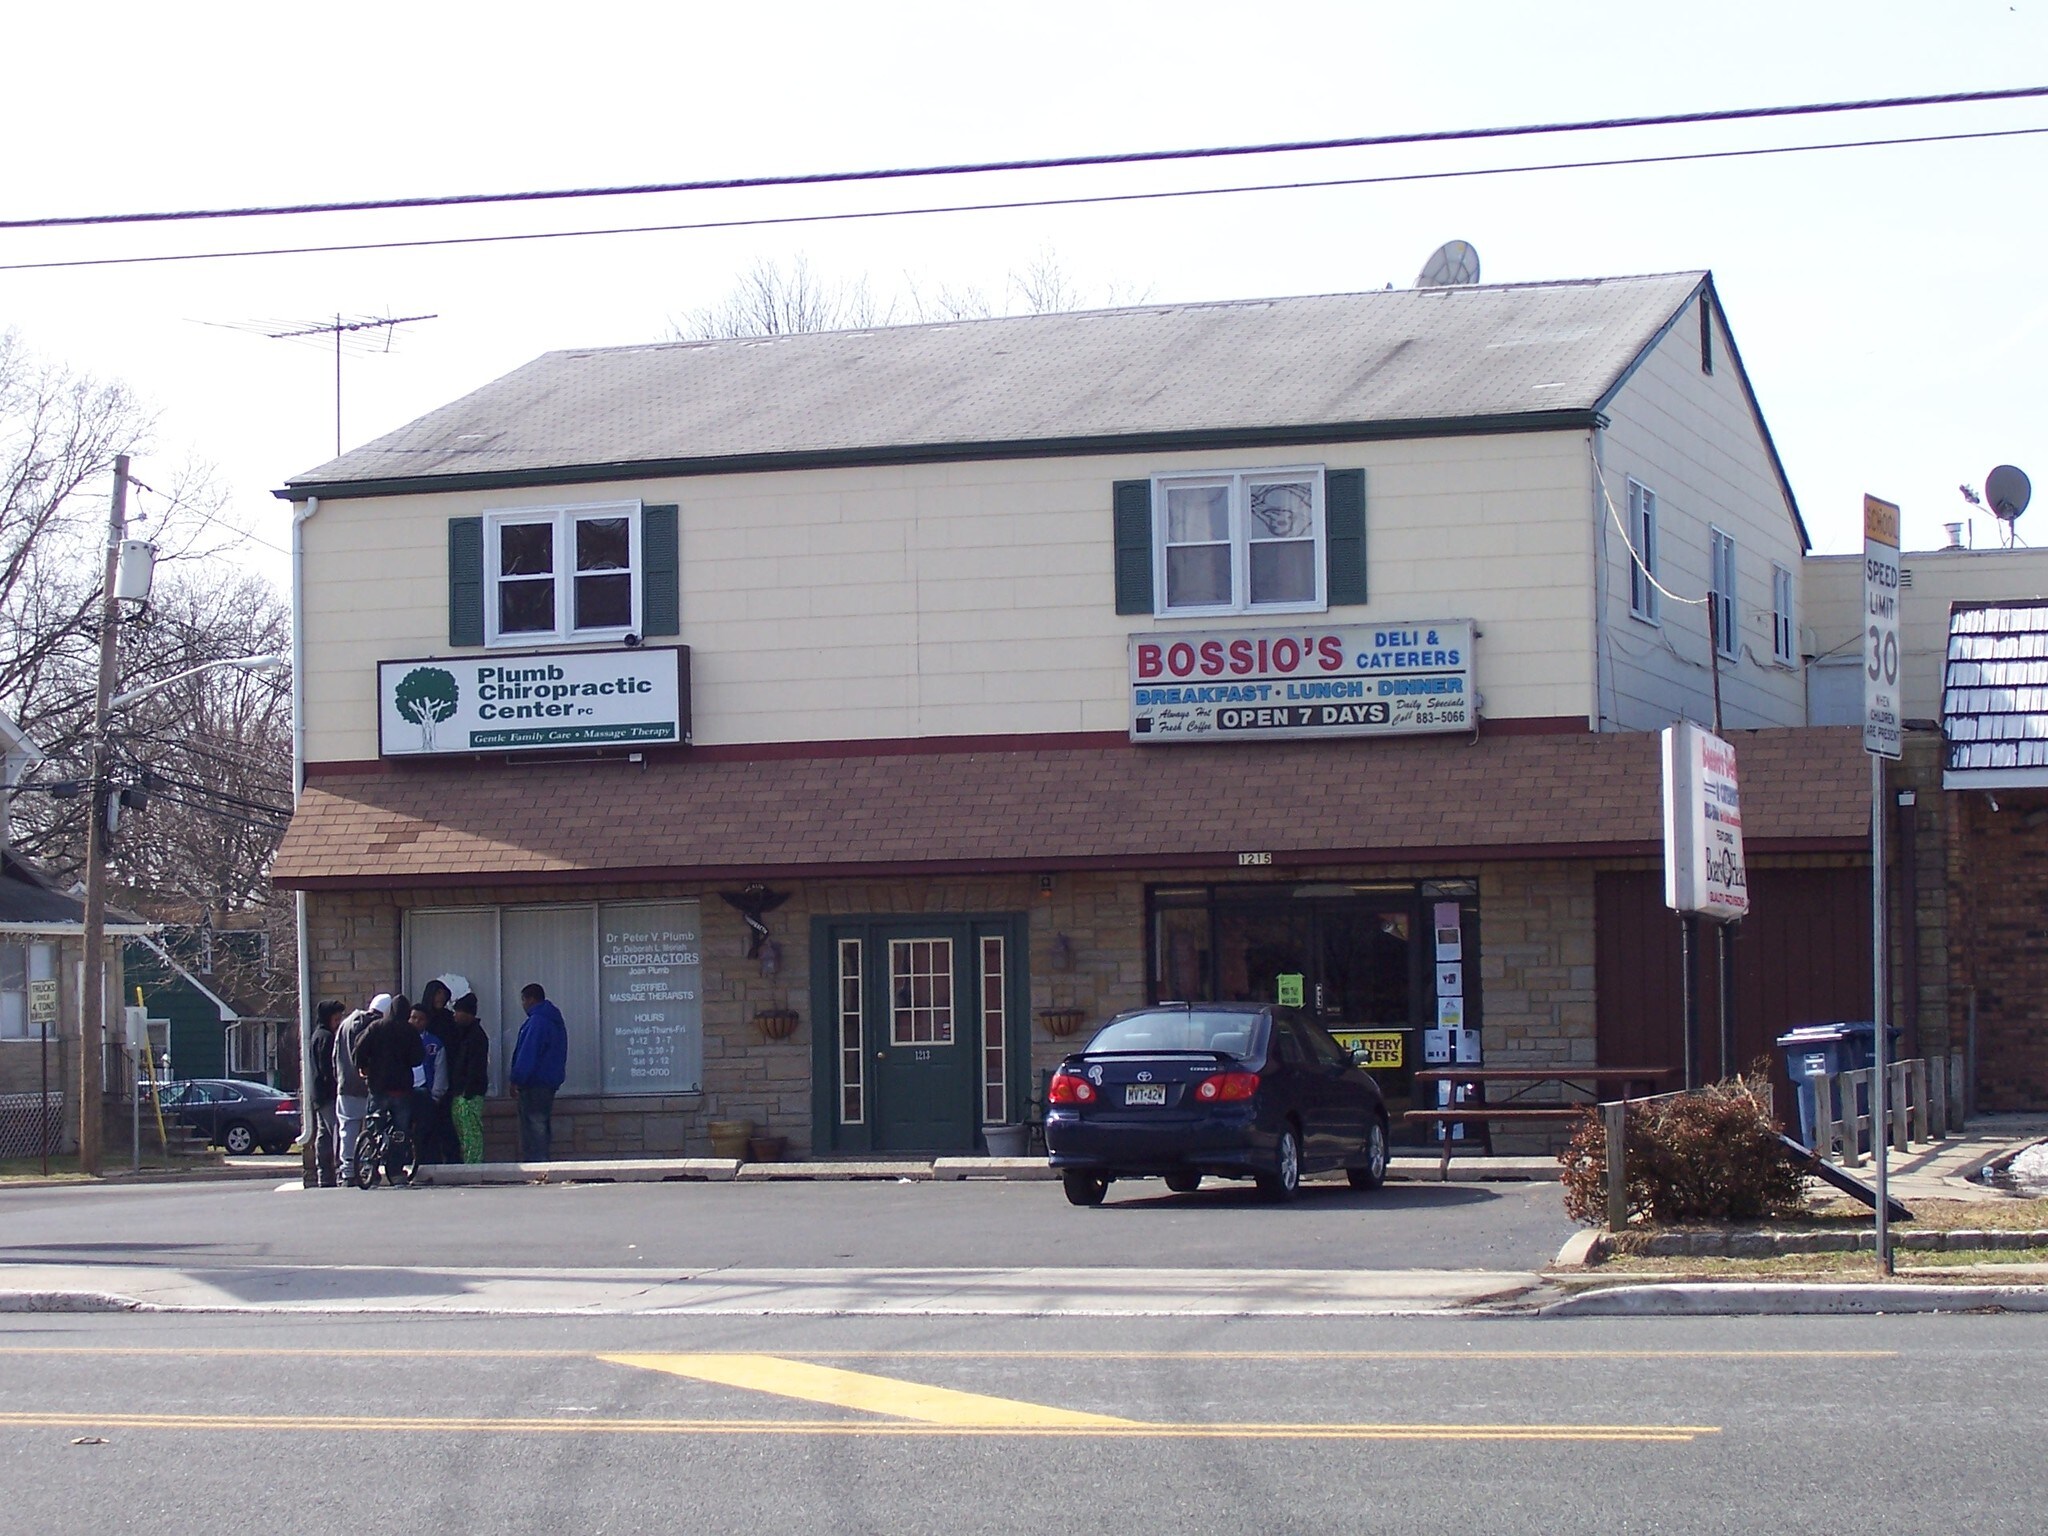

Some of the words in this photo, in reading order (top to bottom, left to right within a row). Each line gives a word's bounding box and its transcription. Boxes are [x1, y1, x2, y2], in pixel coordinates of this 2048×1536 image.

[1867, 558, 1898, 589] SPEED
[1869, 592, 1895, 621] LIMIT
[1138, 635, 1343, 679] BOSSIO'S
[1375, 630, 1418, 648] DELI
[1426, 629, 1440, 646] &
[1356, 649, 1461, 669] CATERERS
[1867, 625, 1898, 686] 30
[477, 664, 564, 684] Plumb
[477, 677, 652, 700] Chiropractic
[1135, 684, 1272, 706] BREAKFAST
[1287, 681, 1363, 701] LUNCH
[1378, 677, 1464, 697] DINNER
[478, 702, 574, 720] Center
[577, 707, 594, 716] PC
[1396, 699, 1422, 711] Daily
[1426, 697, 1465, 710] Specials
[1158, 708, 1190, 720] Always
[1195, 706, 1213, 717] Hot
[1223, 706, 1290, 728] OPEN
[1299, 705, 1313, 725] 7
[1323, 703, 1385, 724] DAYS
[1391, 710, 1414, 727] Call
[1416, 710, 1465, 724] 883-5066
[1158, 721, 1182, 733] Fresh
[1186, 720, 1212, 733] Coffee
[474, 734, 506, 744] Gentle
[510, 732, 545, 743] Family
[548, 730, 571, 740] Care
[584, 729, 627, 740] Massage
[630, 727, 672, 738] Therapy
[1241, 853, 1270, 864] 1215
[606, 933, 618, 943] Dr
[623, 932, 649, 943] Peter
[663, 931, 695, 941] Plumb
[602, 952, 699, 965] CHIROPRACTORS
[629, 967, 646, 976] Joan
[648, 966, 670, 975] Plumb
[609, 992, 646, 1002] MASSAGE
[648, 990, 694, 1001] THERAPISTS
[634, 1013, 665, 1022] HOURS
[1343, 1039, 1400, 1050] LOTTERY
[915, 1050, 931, 1060] 1213
